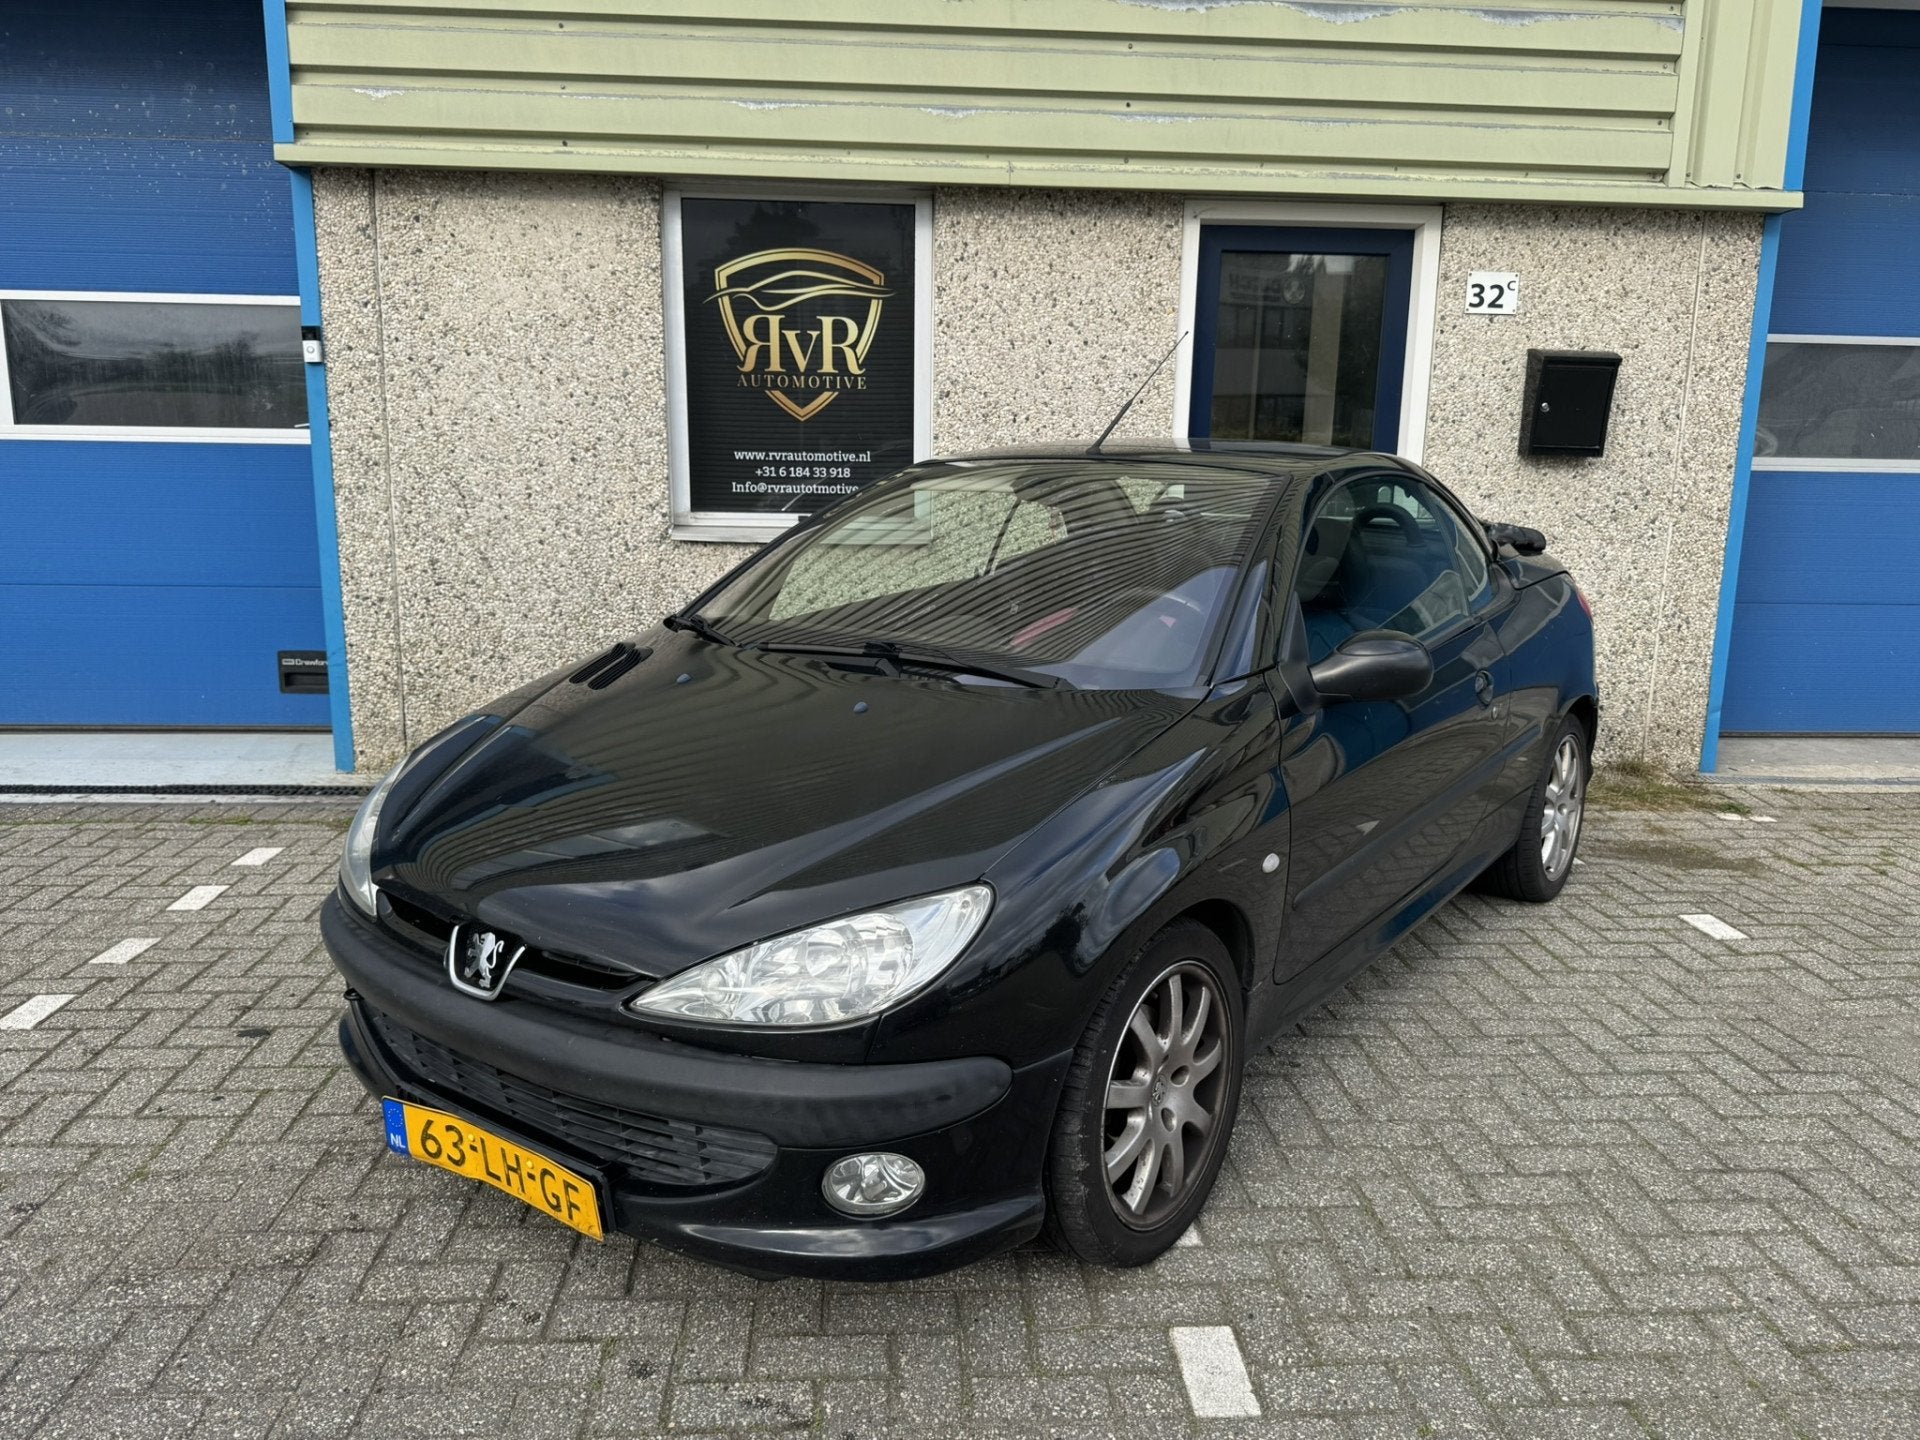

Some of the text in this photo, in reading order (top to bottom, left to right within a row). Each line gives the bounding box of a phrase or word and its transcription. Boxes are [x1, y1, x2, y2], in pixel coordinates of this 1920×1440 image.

[737, 374, 867, 389] AUTOMOTIVE
[734, 450, 871, 462] www.rvrautomotive.nl
[755, 466, 851, 478] +31 6 184 33 918
[390, 1133, 406, 1149] NL
[420, 1119, 580, 1221] 63-LH-GF
